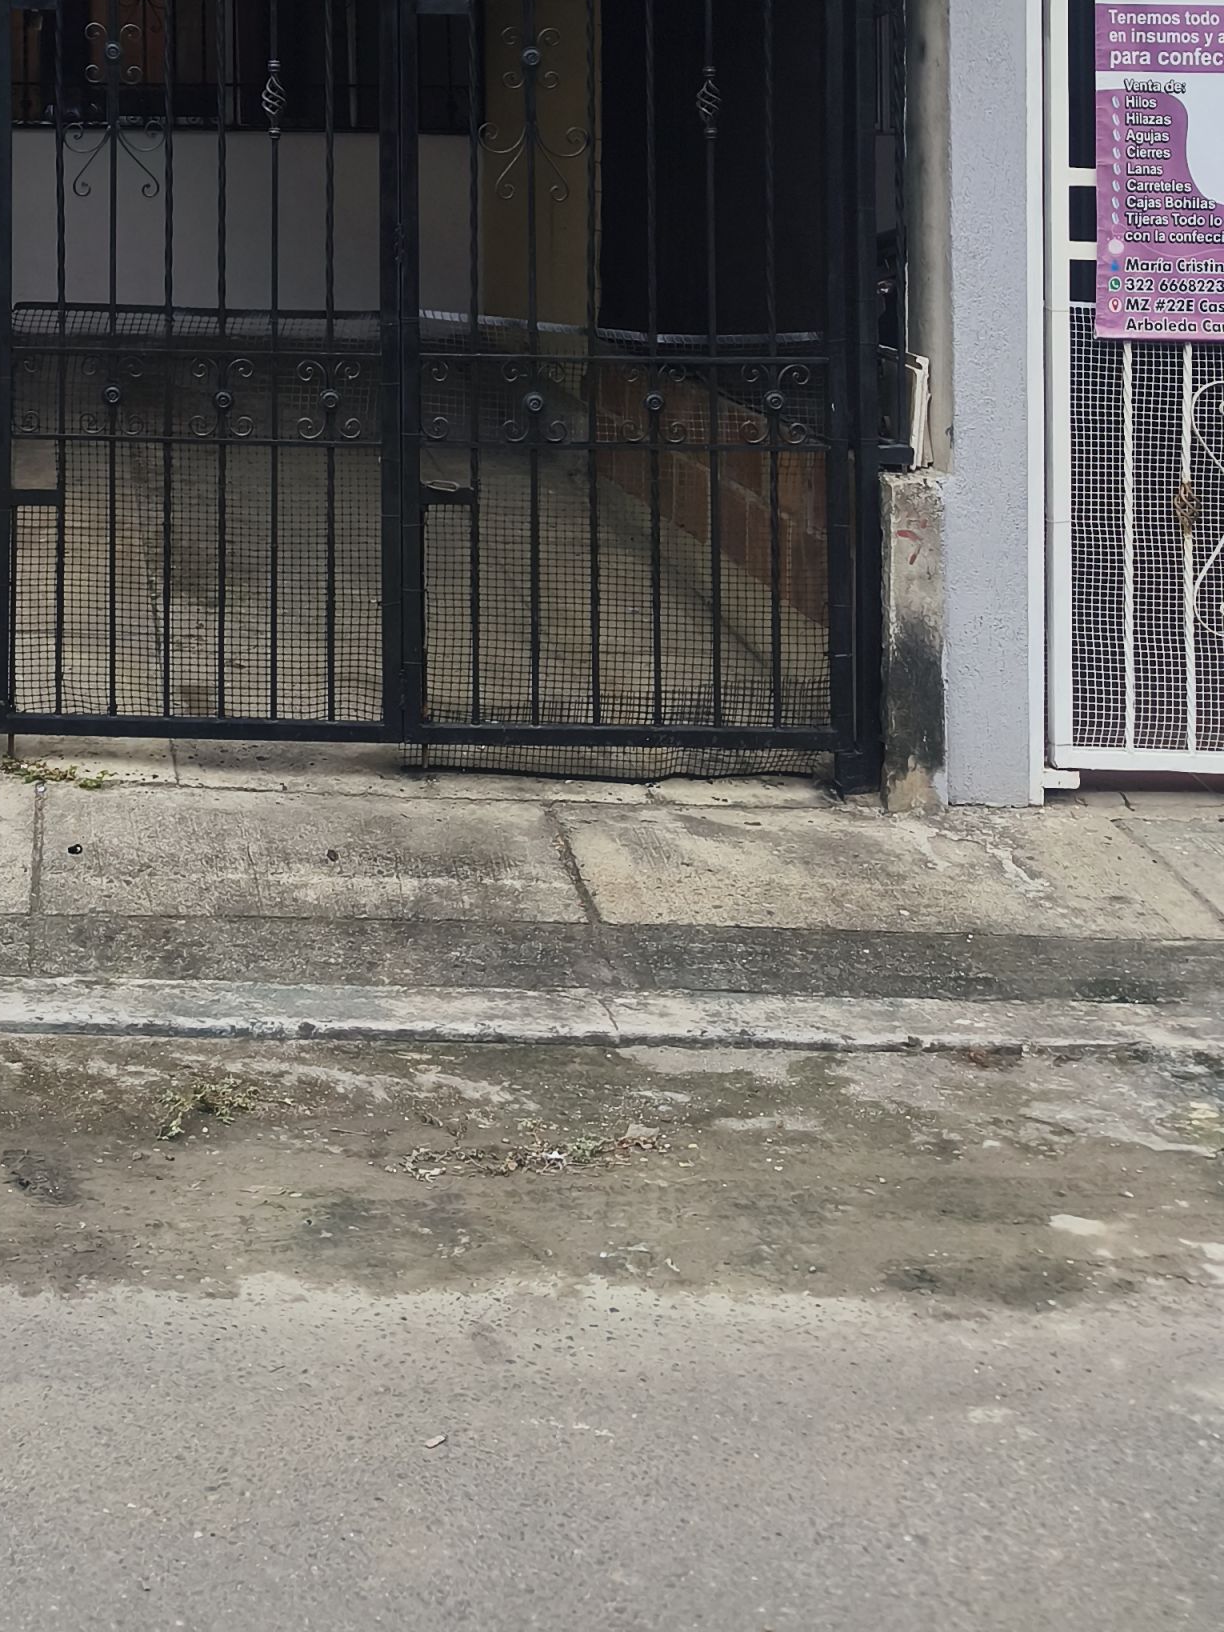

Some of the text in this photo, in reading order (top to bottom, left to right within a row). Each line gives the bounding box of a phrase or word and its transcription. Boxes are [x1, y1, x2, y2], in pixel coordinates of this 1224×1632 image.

[1108, 9, 1220, 26] Tenemos todo
[1109, 31, 1126, 43] en
[1131, 29, 1200, 43] insumos
[1204, 32, 1214, 47] y
[1110, 48, 1224, 68] para confec
[1124, 79, 1187, 93] Venta de:
[1125, 95, 1157, 109] Hilos
[1125, 112, 1172, 126] Hilazas
[1125, 129, 1170, 145] Agujas
[1126, 145, 1171, 159] Cierres
[1127, 162, 1163, 176] Lanas
[1126, 179, 1192, 193] Carreteles
[1126, 196, 1162, 211] Cajas
[1125, 212, 1223, 227] Tijeras Todo lo
[1125, 231, 1151, 243] con
[1155, 231, 1166, 243] la
[1125, 258, 1171, 273] María
[1125, 279, 1224, 293] 322 6668223
[1126, 299, 1150, 312] MZ
[1156, 299, 1194, 312] #22E
[1126, 319, 1196, 332] Arboleda
